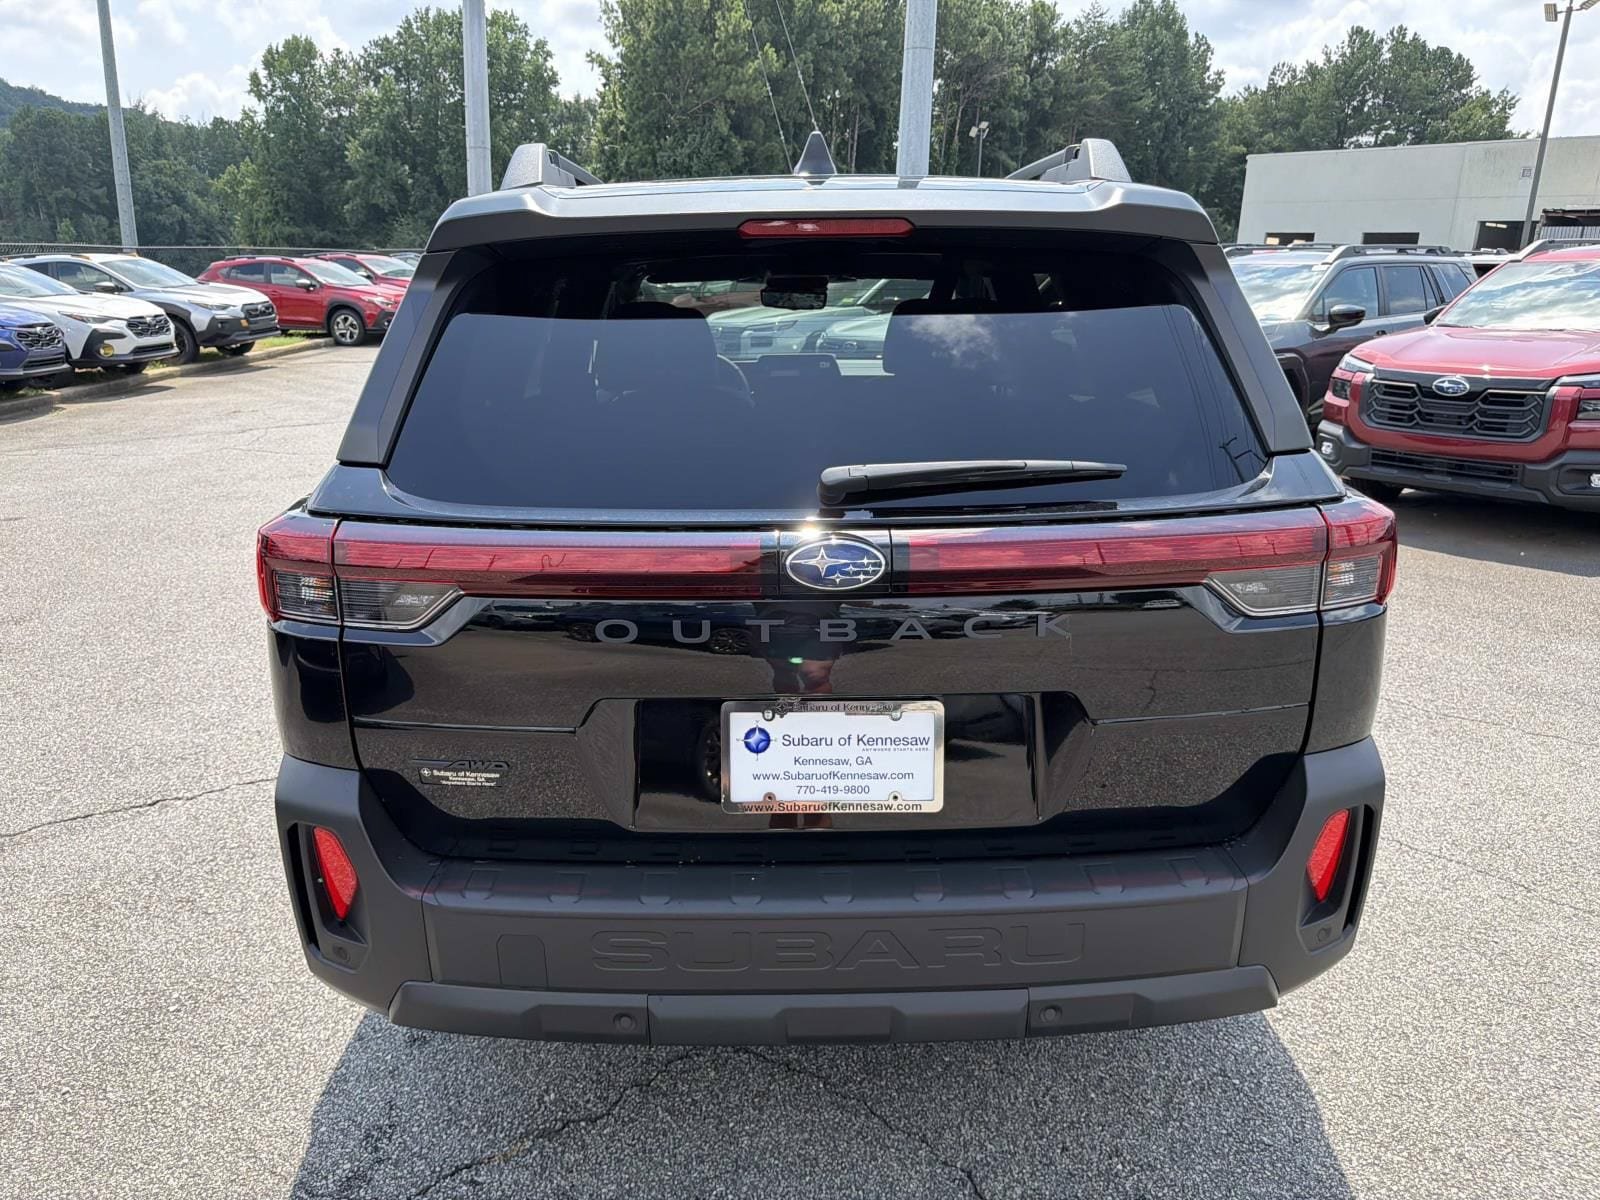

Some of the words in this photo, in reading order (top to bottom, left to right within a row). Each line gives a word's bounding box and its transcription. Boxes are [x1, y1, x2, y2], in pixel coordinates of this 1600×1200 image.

[594, 614, 1073, 644] OUTBACK
[830, 703, 841, 713] of
[782, 733, 833, 747] Subaru
[838, 733, 852, 747] of
[856, 733, 931, 747] Kennesaw
[448, 760, 510, 770] AWD
[793, 756, 853, 768] Kennesaw,
[855, 756, 873, 767] GA
[752, 771, 914, 781] www.SubaruofKennesaw.com
[796, 785, 870, 795] 770-419-9800
[742, 802, 923, 812] www.SubaruofKennesaw.com
[590, 922, 1085, 973] SUBARU
